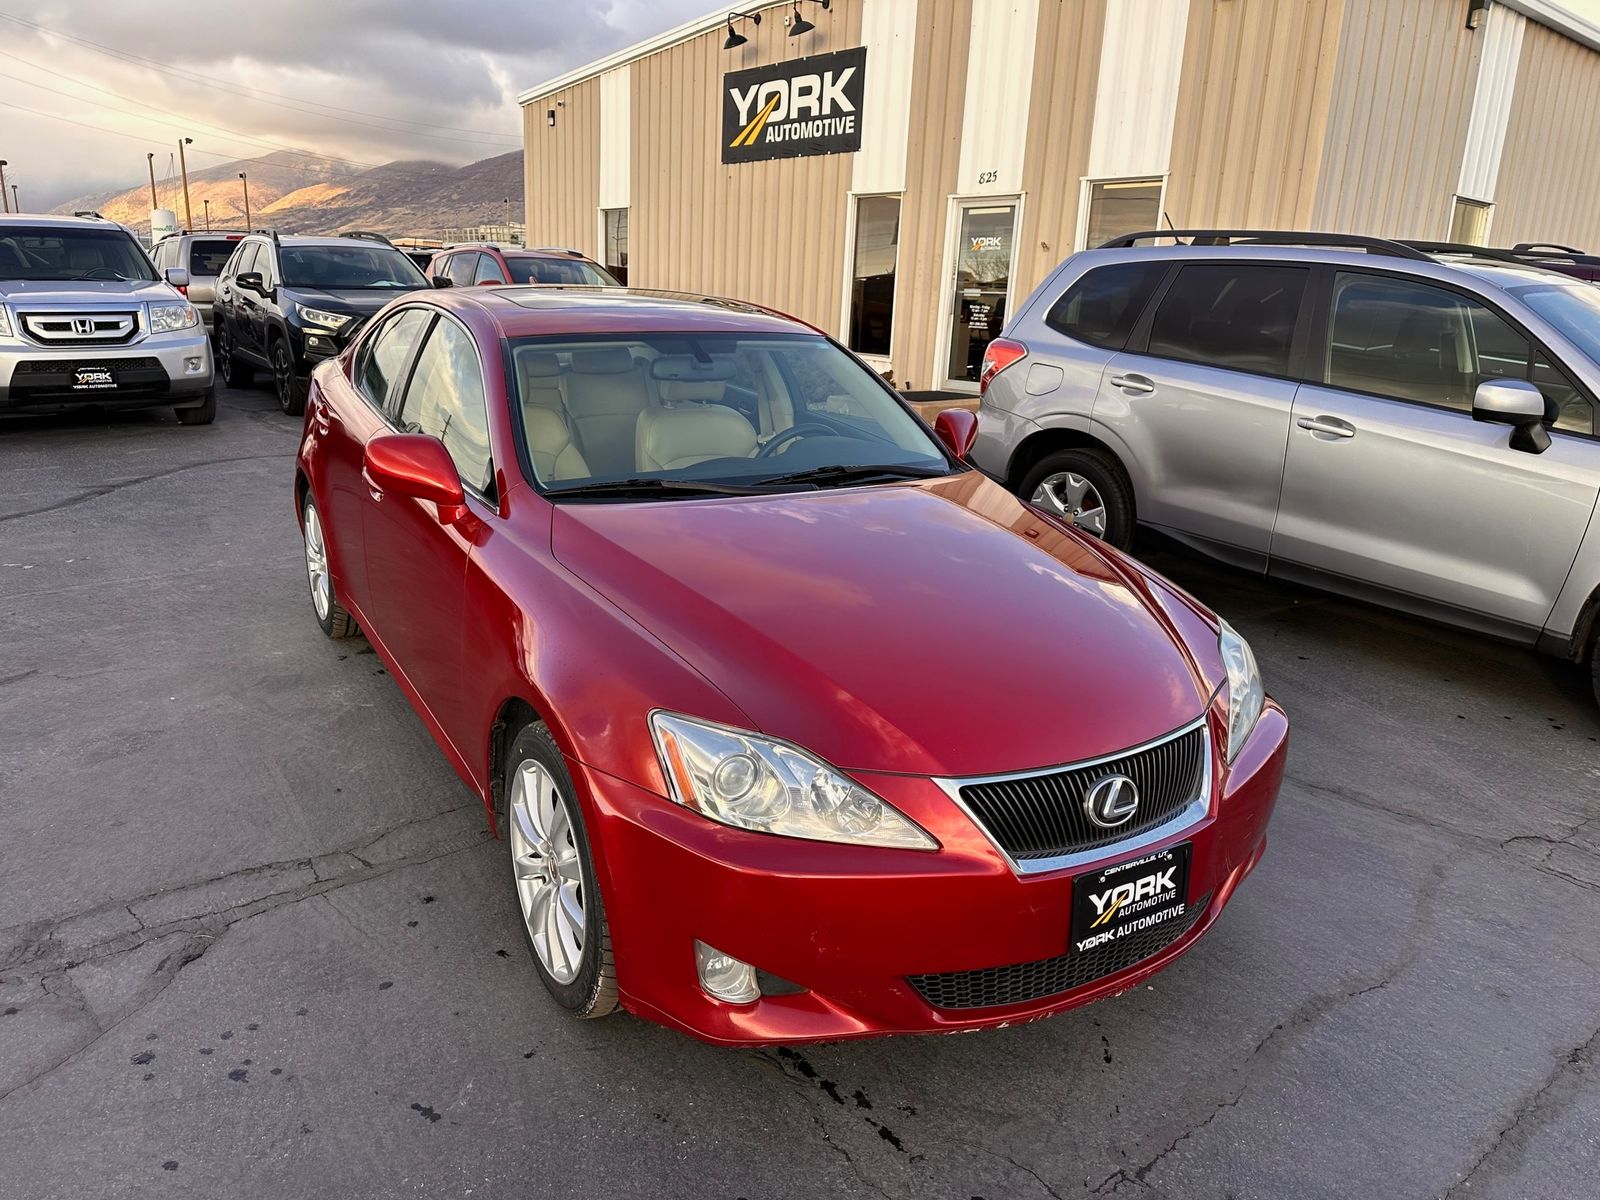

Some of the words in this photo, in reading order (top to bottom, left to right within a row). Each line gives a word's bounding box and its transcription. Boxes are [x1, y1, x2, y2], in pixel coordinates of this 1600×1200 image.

[729, 67, 857, 127] YORK
[765, 115, 855, 143] AUTOMOTIVE
[978, 169, 998, 185] 825
[970, 236, 1002, 247] YORK
[75, 372, 112, 382] YORK
[1088, 865, 1177, 916] YORK
[1118, 888, 1177, 918] AUTOMOTIVE
[1076, 929, 1116, 952] YORK
[1116, 903, 1186, 938] AUTOMOTIVE
